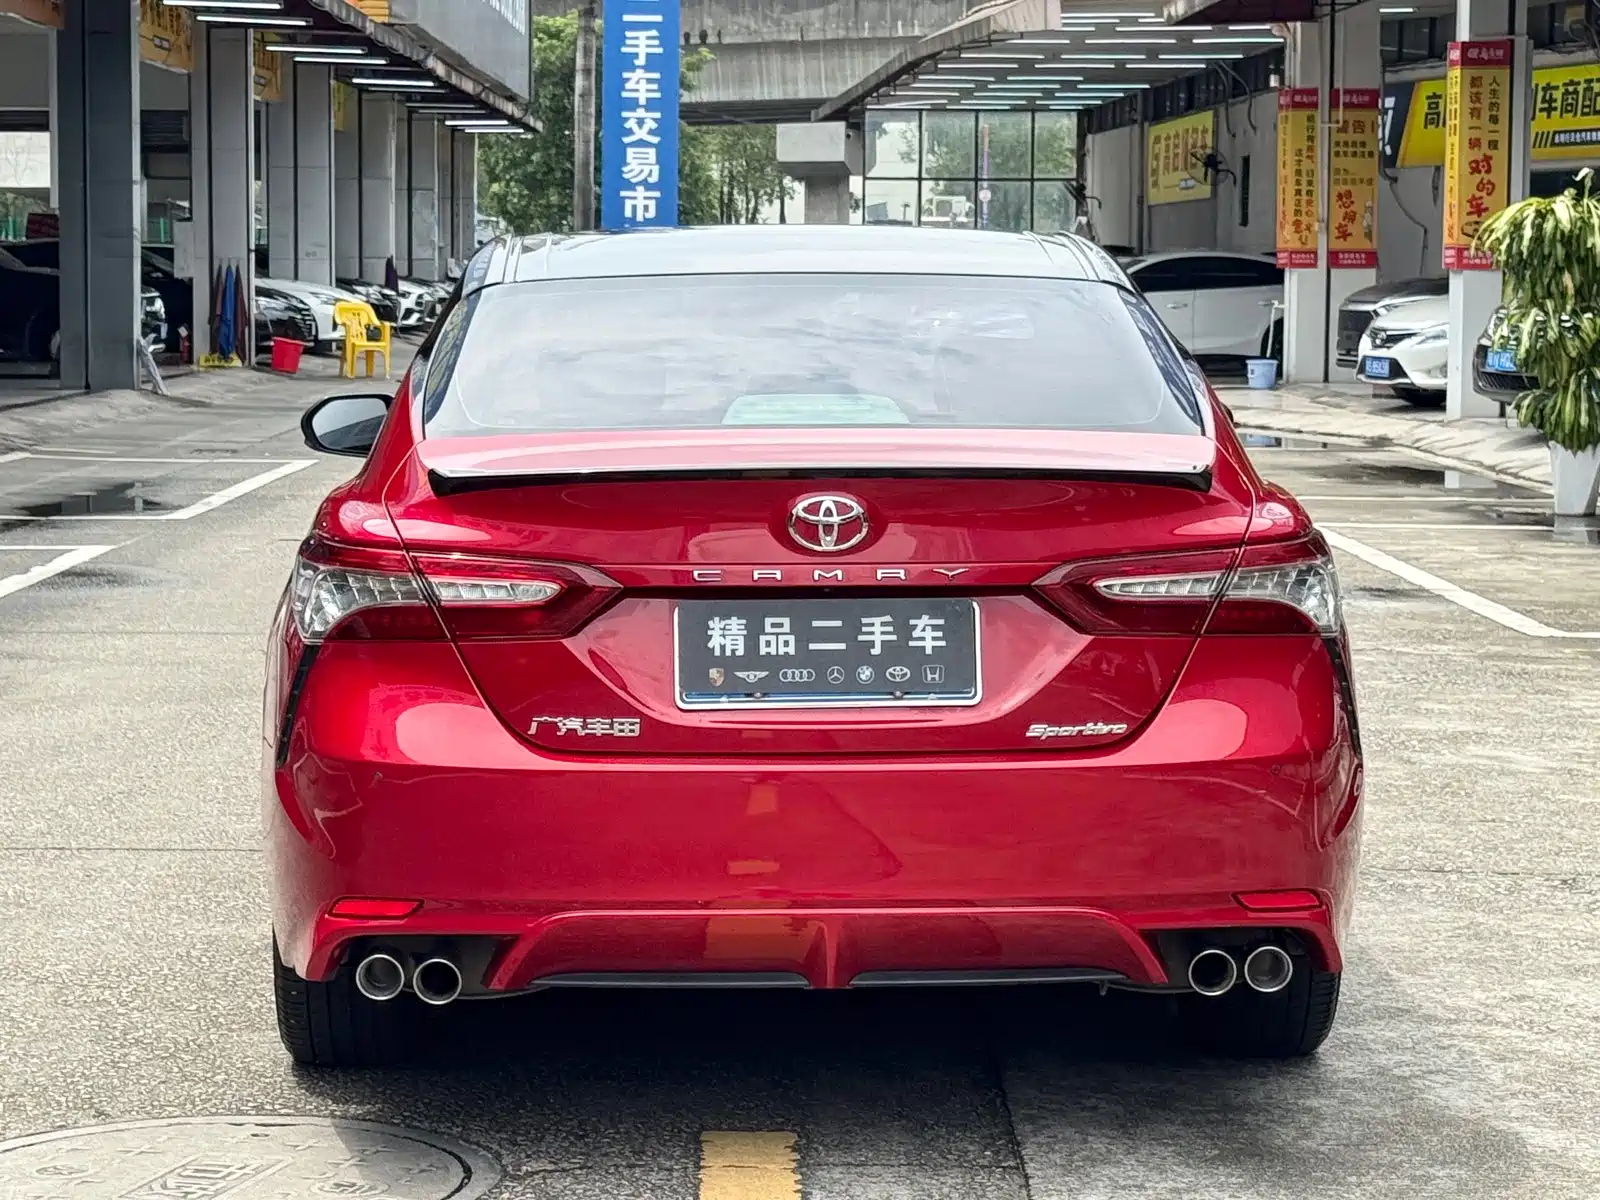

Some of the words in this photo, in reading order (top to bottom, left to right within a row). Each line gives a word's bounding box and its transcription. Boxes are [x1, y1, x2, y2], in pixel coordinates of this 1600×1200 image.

[620, 0, 664, 222] 二手车交易市
[692, 567, 971, 582] CAMRY
[706, 614, 948, 657] 精品二手车
[527, 716, 641, 737] 广汽丰田
